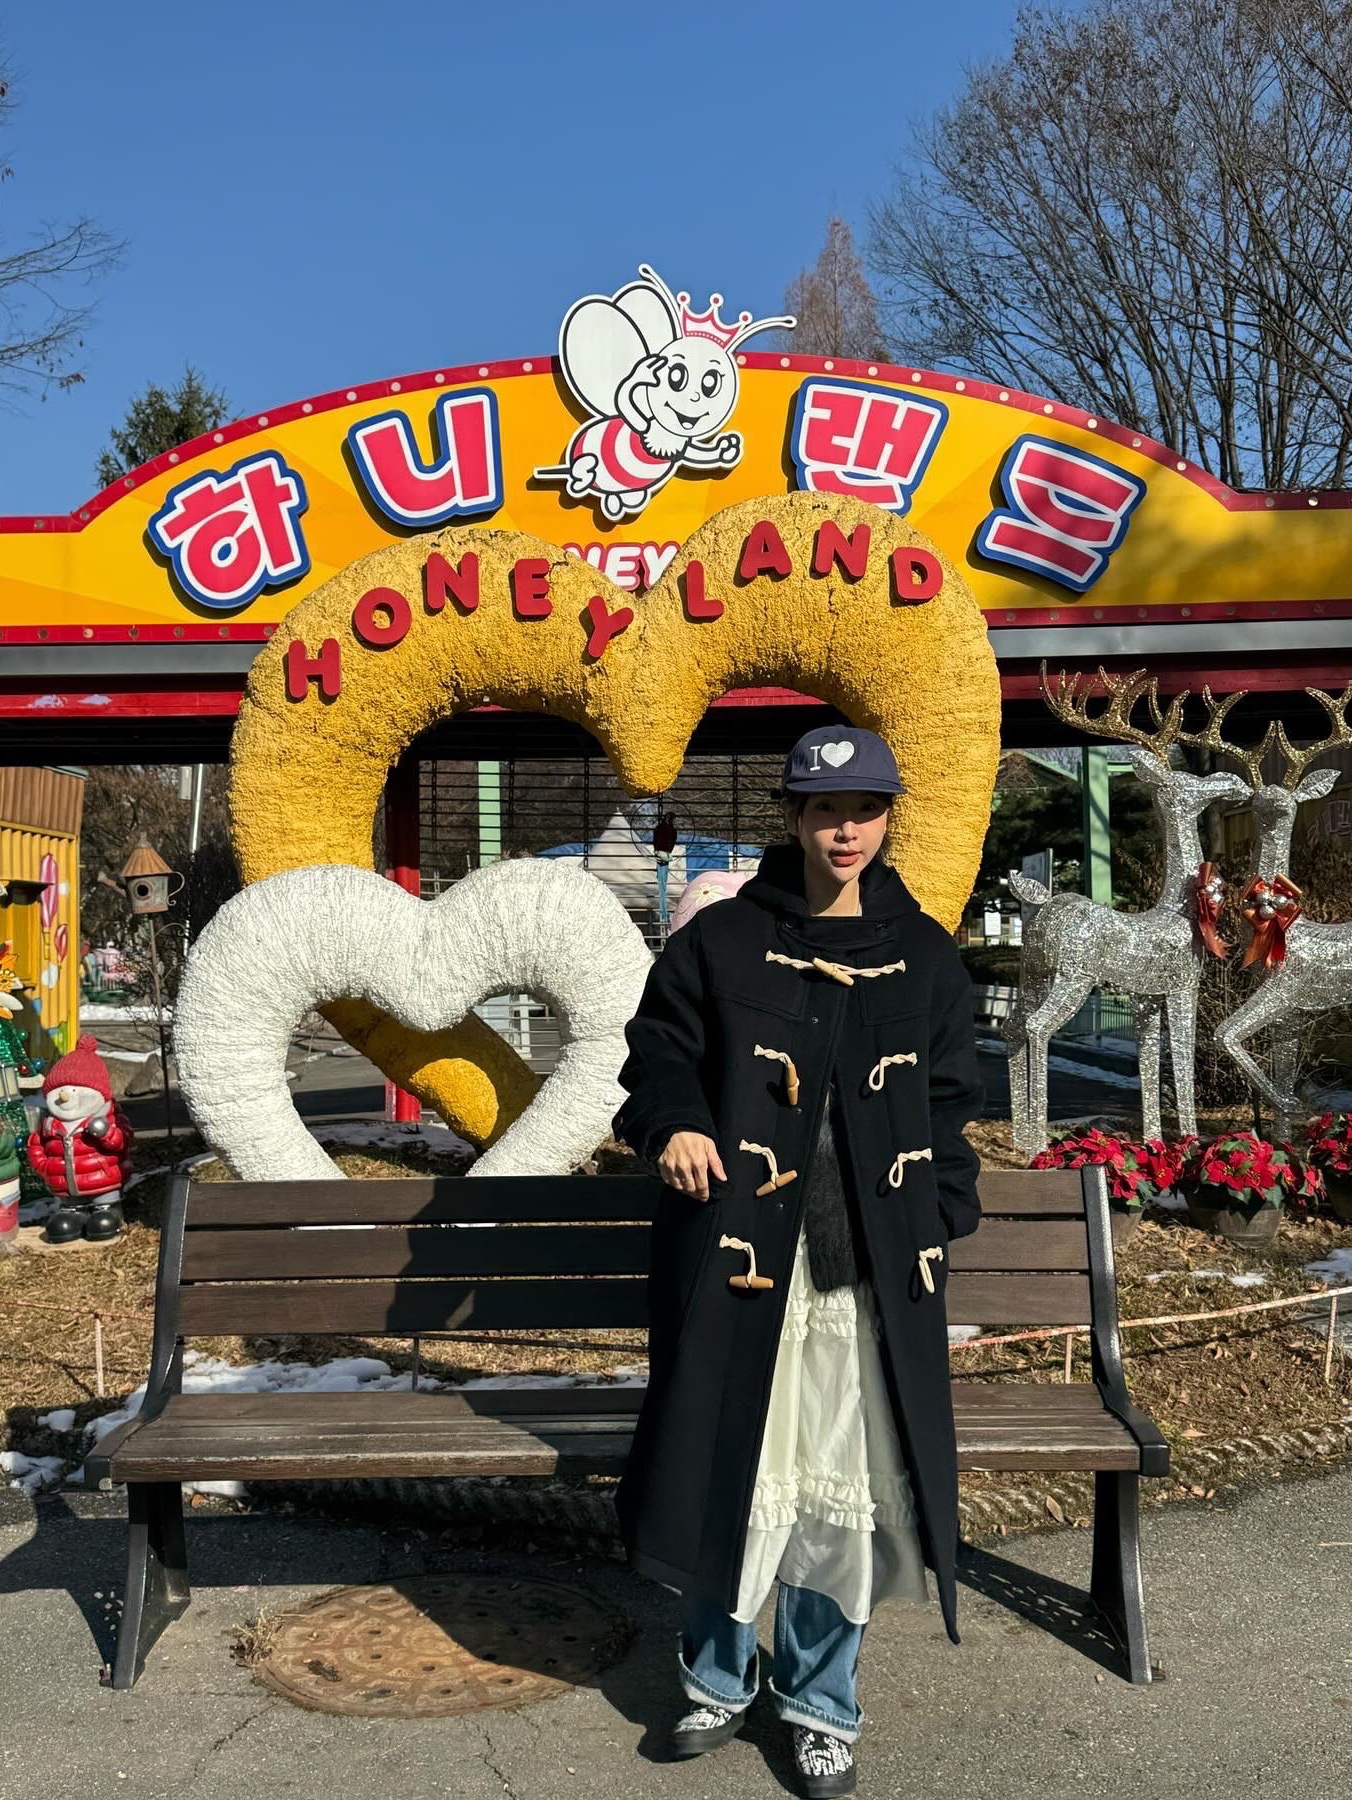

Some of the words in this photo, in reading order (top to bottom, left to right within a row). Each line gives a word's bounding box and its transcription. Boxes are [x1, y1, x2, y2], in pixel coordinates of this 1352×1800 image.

[287, 551, 634, 699] HONEY
[684, 520, 944, 623] LAND
[809, 745, 821, 771] I
